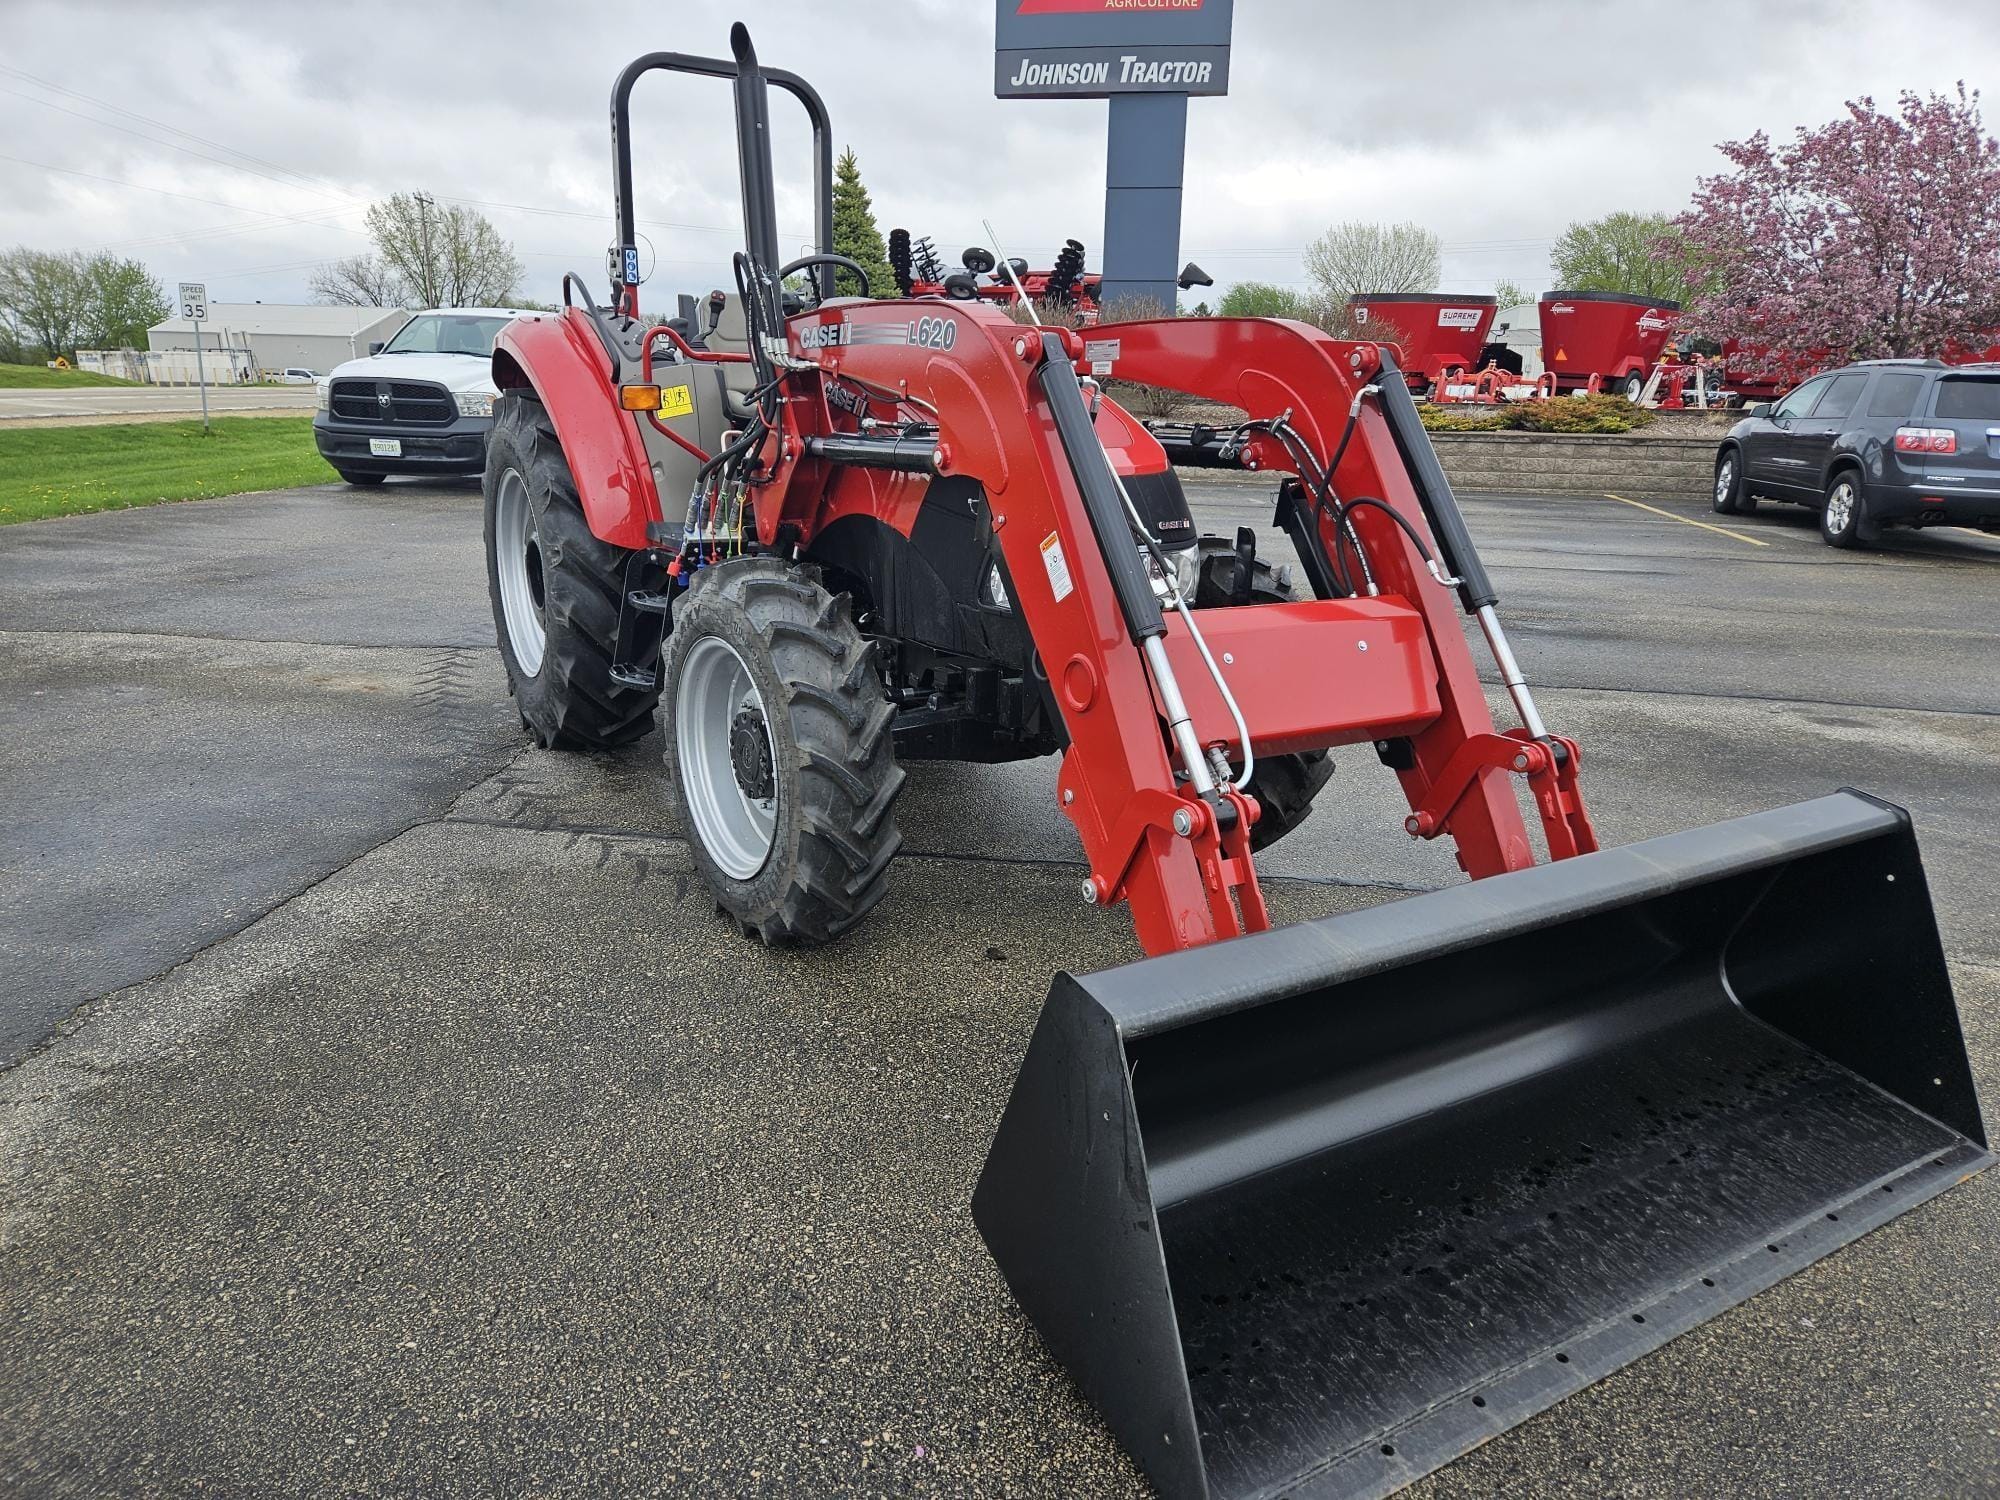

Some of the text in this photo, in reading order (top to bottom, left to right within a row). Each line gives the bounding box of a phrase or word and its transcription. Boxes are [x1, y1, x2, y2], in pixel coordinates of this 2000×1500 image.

[1011, 56, 1212, 87] JOHNSON TRACTOR
[184, 303, 205, 318] 35
[1442, 311, 1478, 320] SUPREME
[800, 324, 838, 349] CASE
[908, 316, 957, 351] L620
[824, 381, 856, 412] CASE
[1158, 520, 1183, 530] CASE
